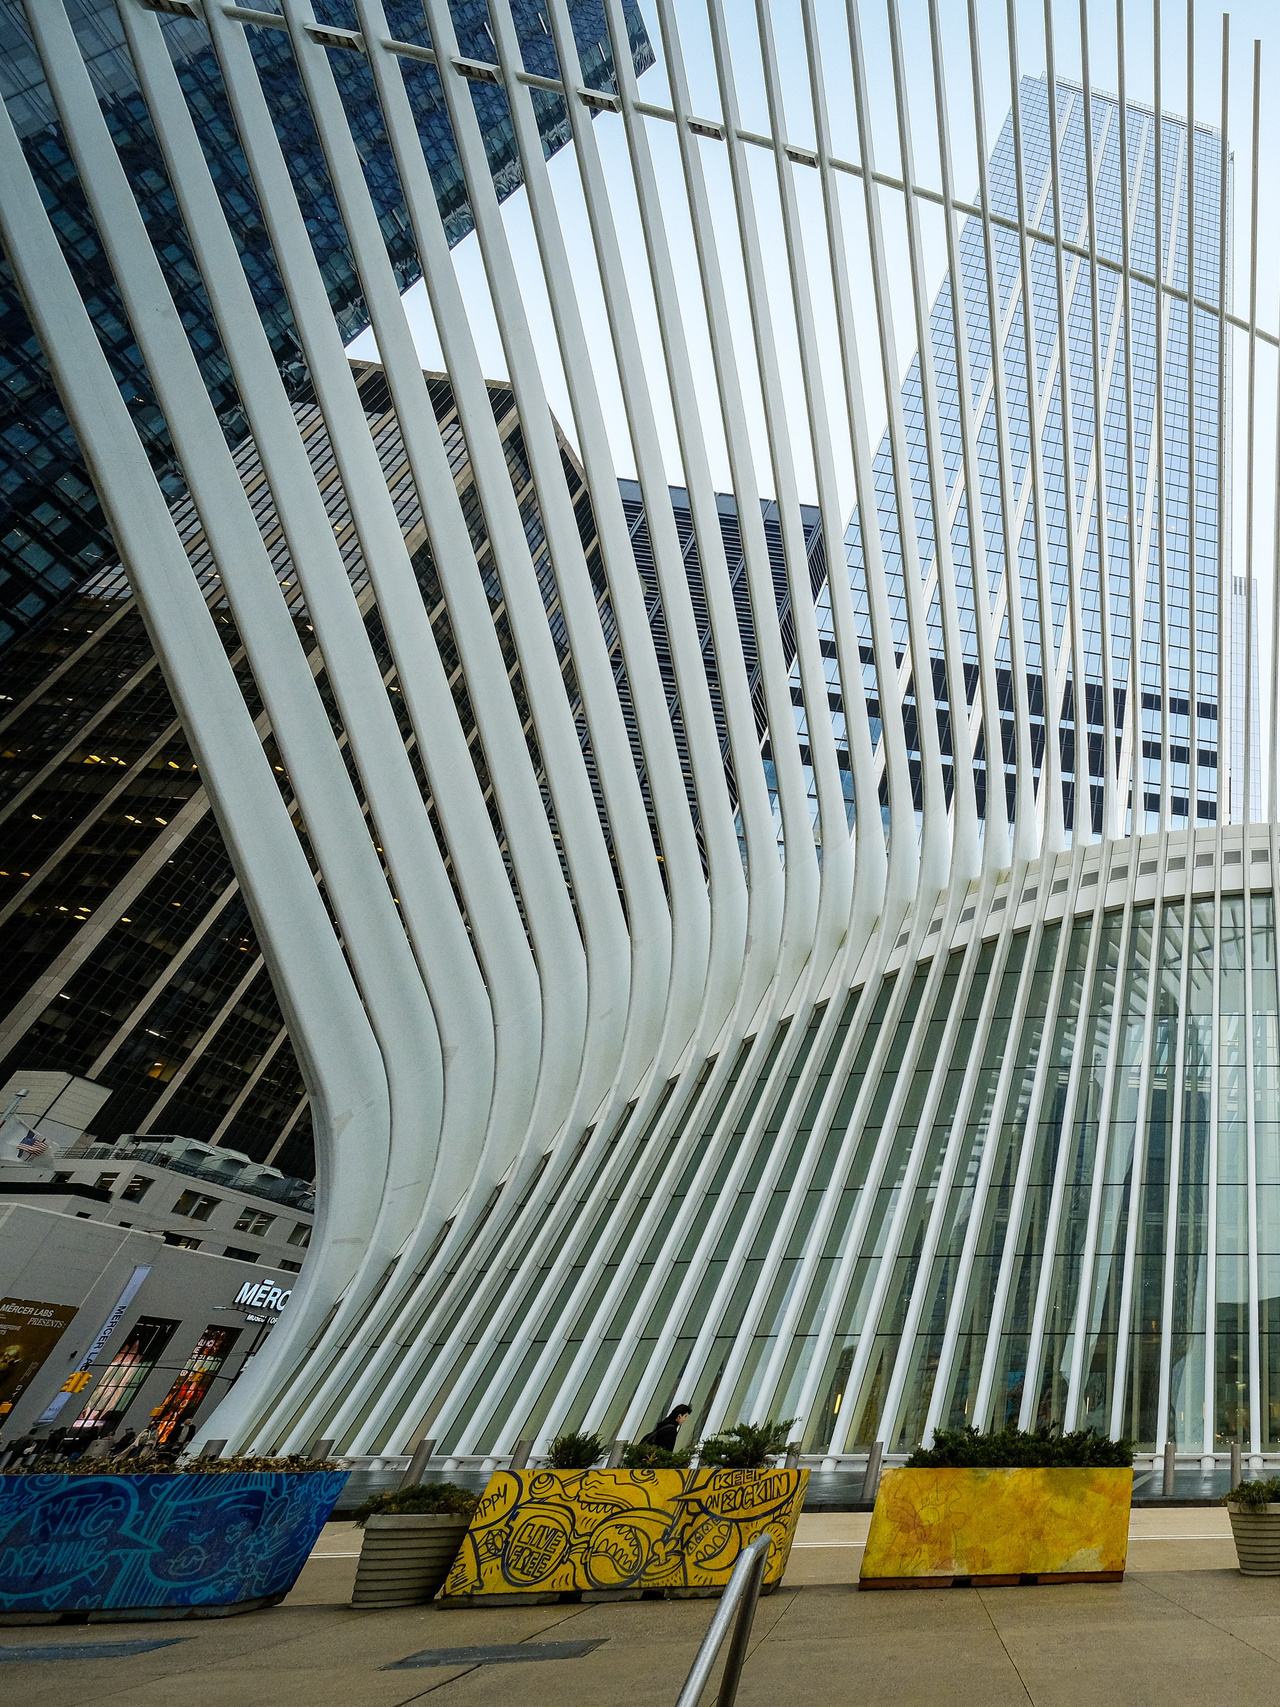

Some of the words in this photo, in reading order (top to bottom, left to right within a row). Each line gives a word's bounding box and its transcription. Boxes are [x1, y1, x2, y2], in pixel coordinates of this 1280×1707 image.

[33, 1308, 54, 1317] LABS
[94, 1305, 126, 1349] MERCER
[705, 1493, 720, 1510] ON
[720, 1472, 790, 1513] ROCKIN
[0, 1536, 108, 1577] DREAMING
[517, 1523, 565, 1554] LIVE
[508, 1545, 551, 1579] FREE
